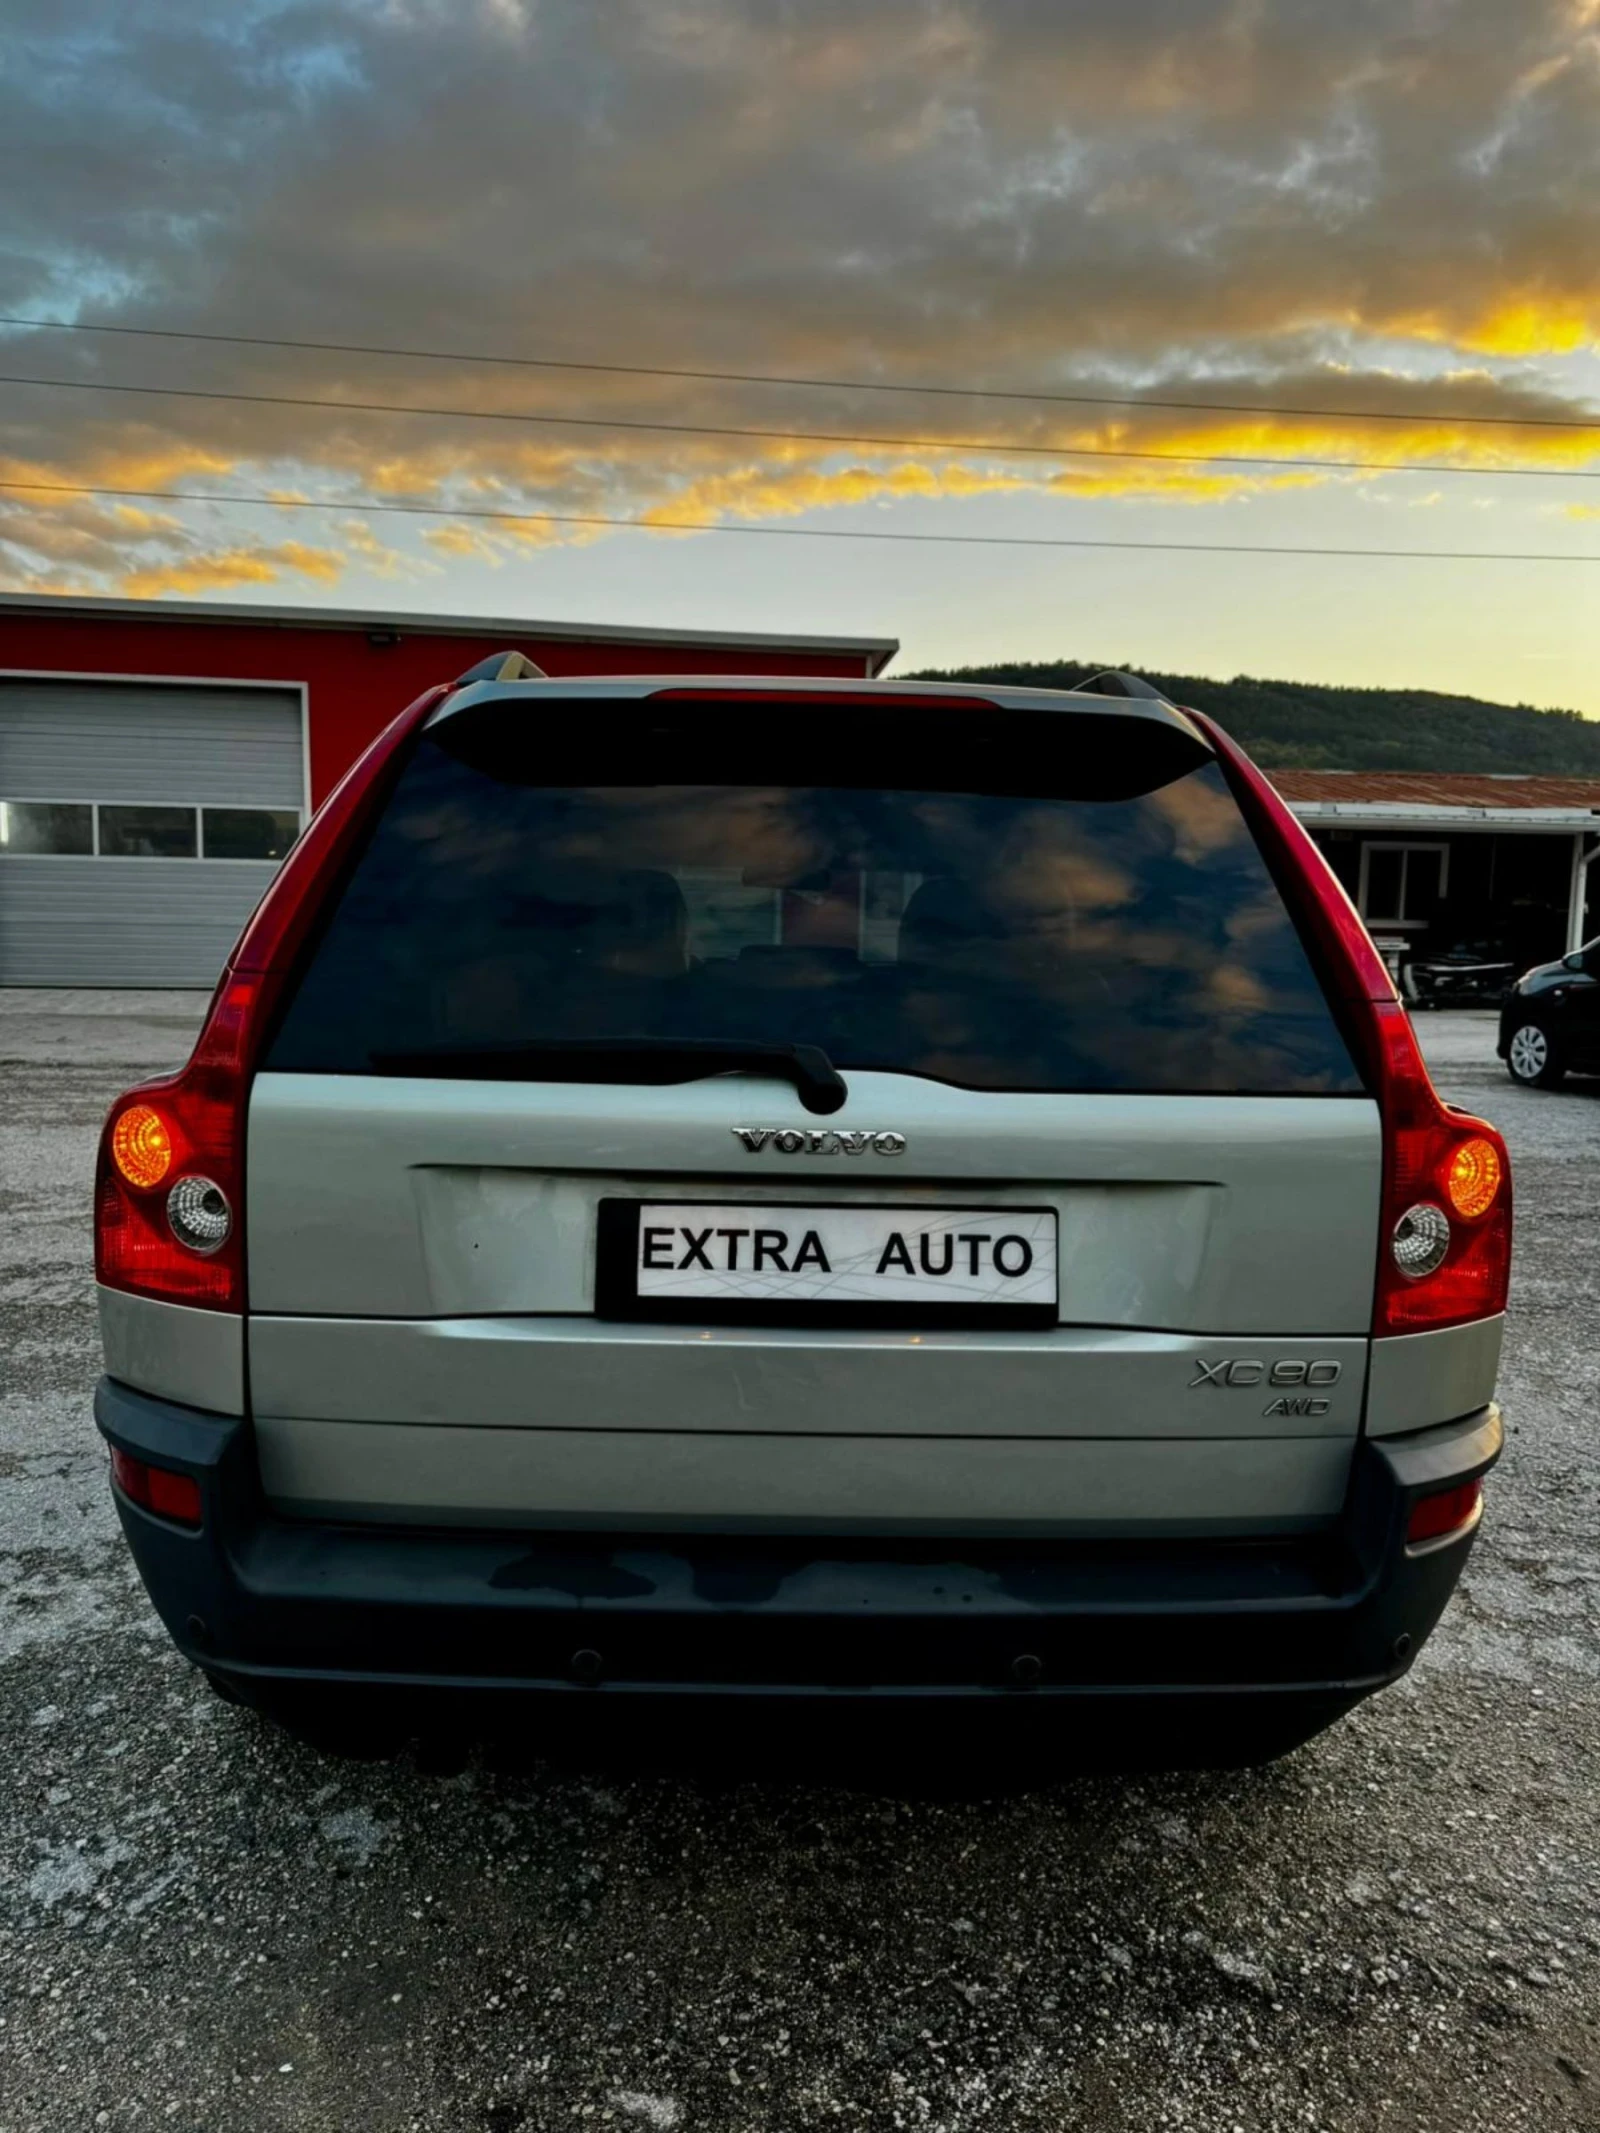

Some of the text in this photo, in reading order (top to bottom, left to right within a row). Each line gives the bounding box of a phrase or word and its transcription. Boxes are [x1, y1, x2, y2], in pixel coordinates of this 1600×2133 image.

[731, 1127, 906, 1156] VOLVO
[642, 1227, 1033, 1278] EXTRA AUTO
[1263, 1398, 1331, 1417] AWD
